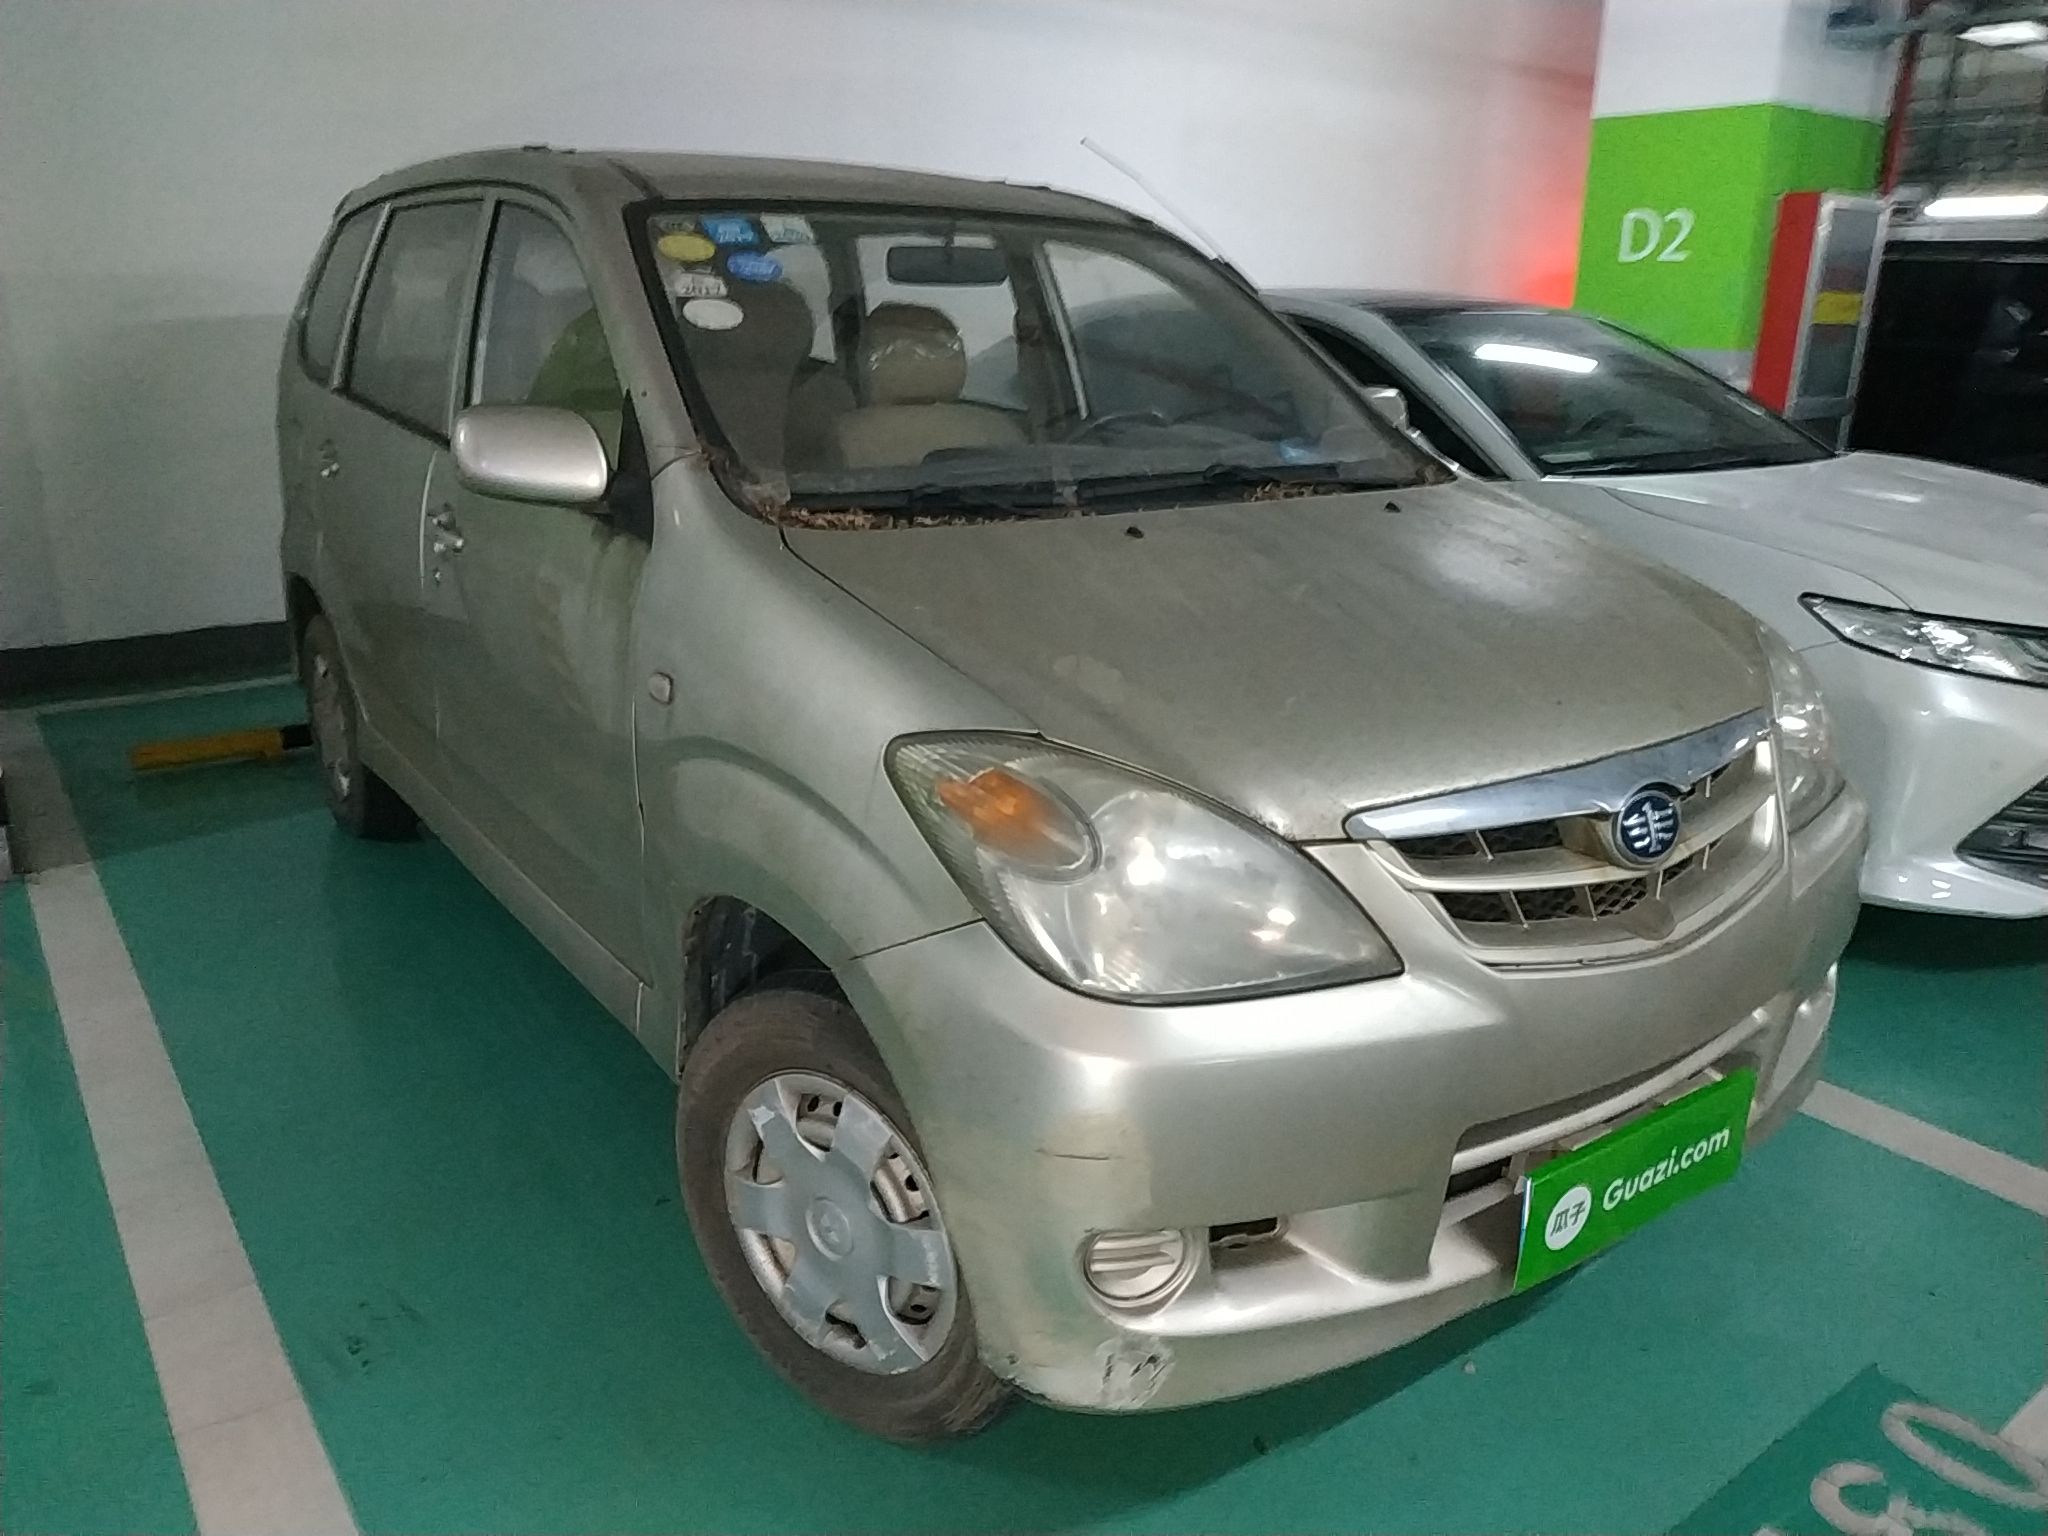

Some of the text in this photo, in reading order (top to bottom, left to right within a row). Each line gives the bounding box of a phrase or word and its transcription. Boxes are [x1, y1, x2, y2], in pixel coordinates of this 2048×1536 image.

[1618, 207, 1695, 263] D2
[1602, 1127, 1731, 1211] Guazi.com
[1550, 1200, 1586, 1237] 瓜子
